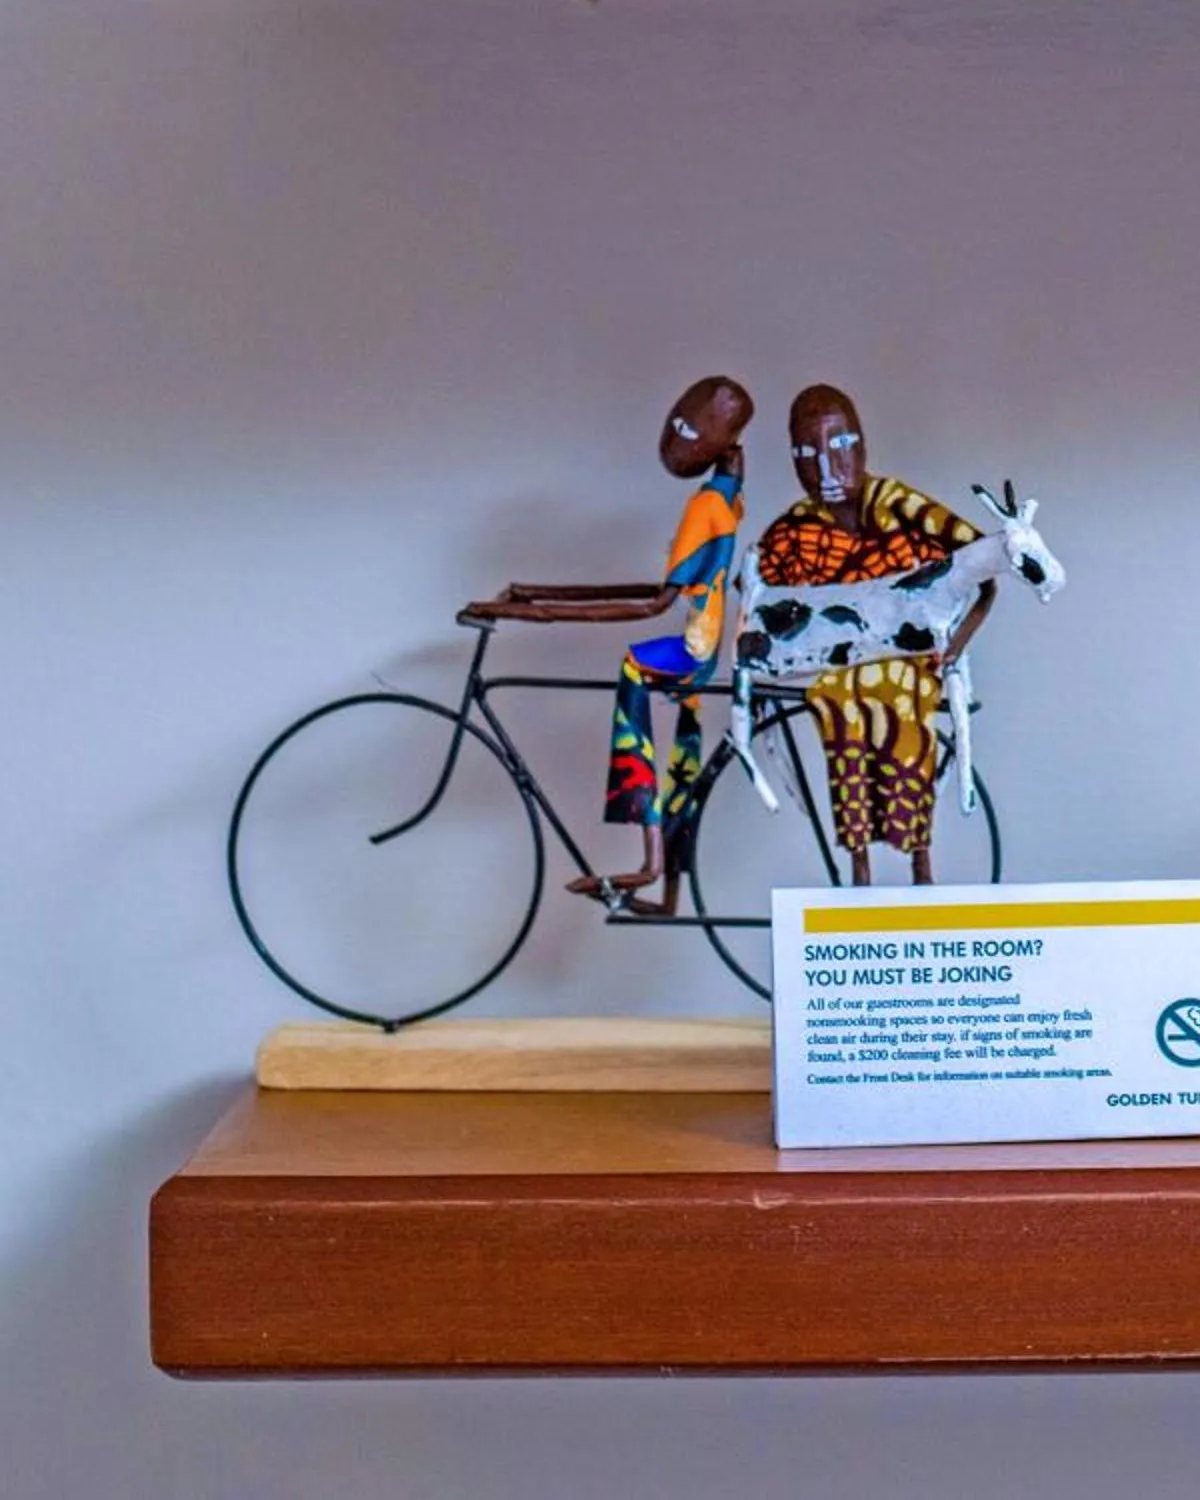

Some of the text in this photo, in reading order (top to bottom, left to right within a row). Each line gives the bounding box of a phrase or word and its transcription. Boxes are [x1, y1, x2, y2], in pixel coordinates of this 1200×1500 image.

[805, 939, 1043, 961] SMOKING IN THE ROOM?
[805, 966, 1013, 986] YOU MUST BE JOKING
[807, 994, 1020, 1012] All of our guestrooms are designated
[890, 1016, 928, 1028] spaces
[931, 1015, 944, 1024] so
[947, 1013, 1000, 1026] everyone
[1004, 1013, 1024, 1023] can
[1027, 1011, 1060, 1024] enjoy
[1063, 1009, 1092, 1020] fresh
[807, 1033, 838, 1044] clean
[841, 1033, 857, 1044] air
[860, 1032, 898, 1046] during
[901, 1031, 928, 1042] their
[960, 1029, 972, 1040] if
[973, 1030, 1002, 1043] signs
[1005, 1028, 1020, 1040] of
[1021, 1028, 1072, 1041] smoking
[1075, 1029, 1092, 1038] are
[807, 1049, 845, 1062] found,
[858, 1049, 888, 1060] $200
[891, 1048, 940, 1062] cleaning
[944, 1047, 962, 1059] fee
[965, 1046, 987, 1058] will
[990, 1046, 1005, 1057] be
[1008, 1044, 1056, 1059] charged.
[845, 1073, 860, 1083] the
[891, 1071, 914, 1082] Desk
[917, 1071, 931, 1081] for
[1106, 1092, 1173, 1107] GOLDEN
